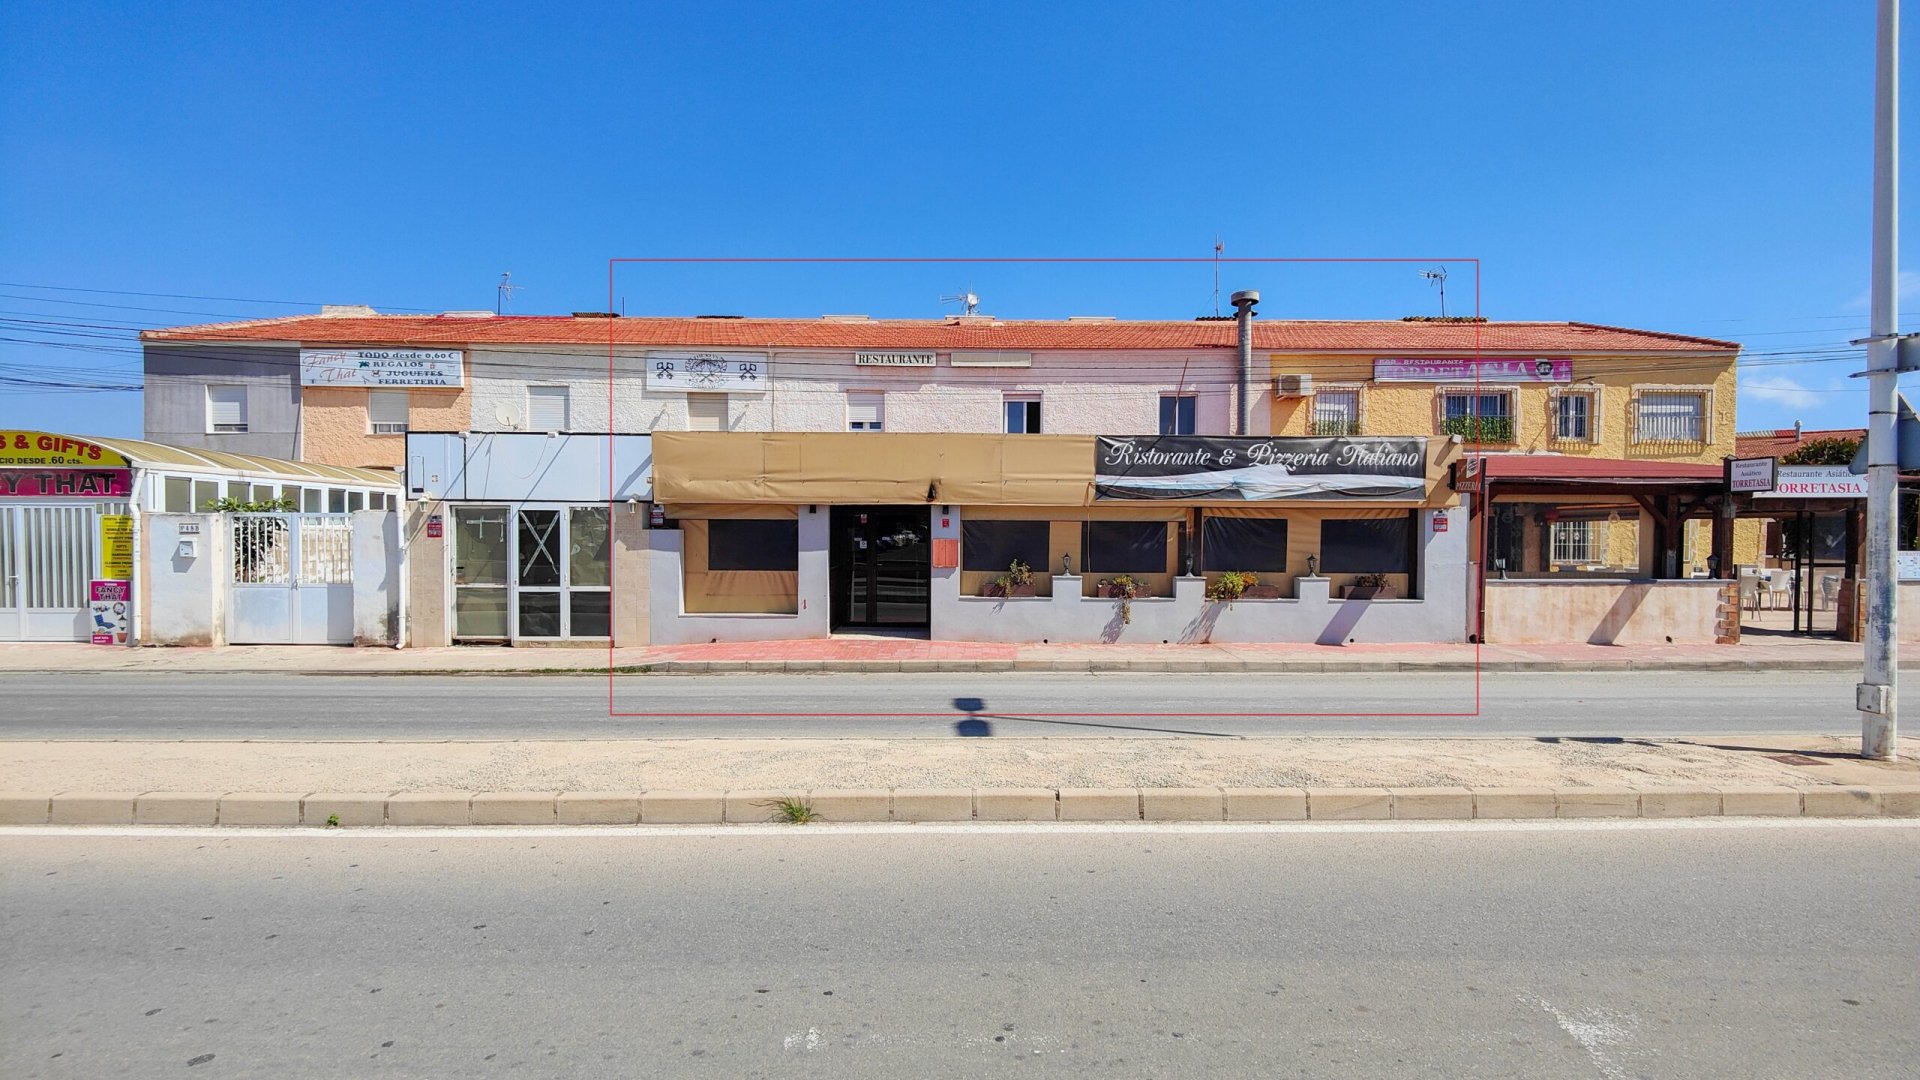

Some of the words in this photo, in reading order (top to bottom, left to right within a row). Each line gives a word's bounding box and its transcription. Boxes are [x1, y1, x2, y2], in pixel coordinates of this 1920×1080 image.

[858, 354, 934, 364] RESTAURANTE
[14, 434, 30, 449] &
[37, 435, 102, 460] GIFTS
[17, 457, 46, 465] DESDE
[1104, 441, 1211, 466] Ristorante
[1219, 448, 1236, 466] &
[1247, 441, 1328, 472] Pizzeria
[1336, 442, 1419, 467] Italiano
[1779, 470, 1823, 478] Restaurante
[0, 472, 24, 495] Y
[33, 471, 117, 495] THAT
[1732, 479, 1771, 489] TORRETASIA
[1777, 483, 1862, 494] ORRETASIA
[96, 586, 125, 594] FANCY
[99, 593, 122, 601] THAT
